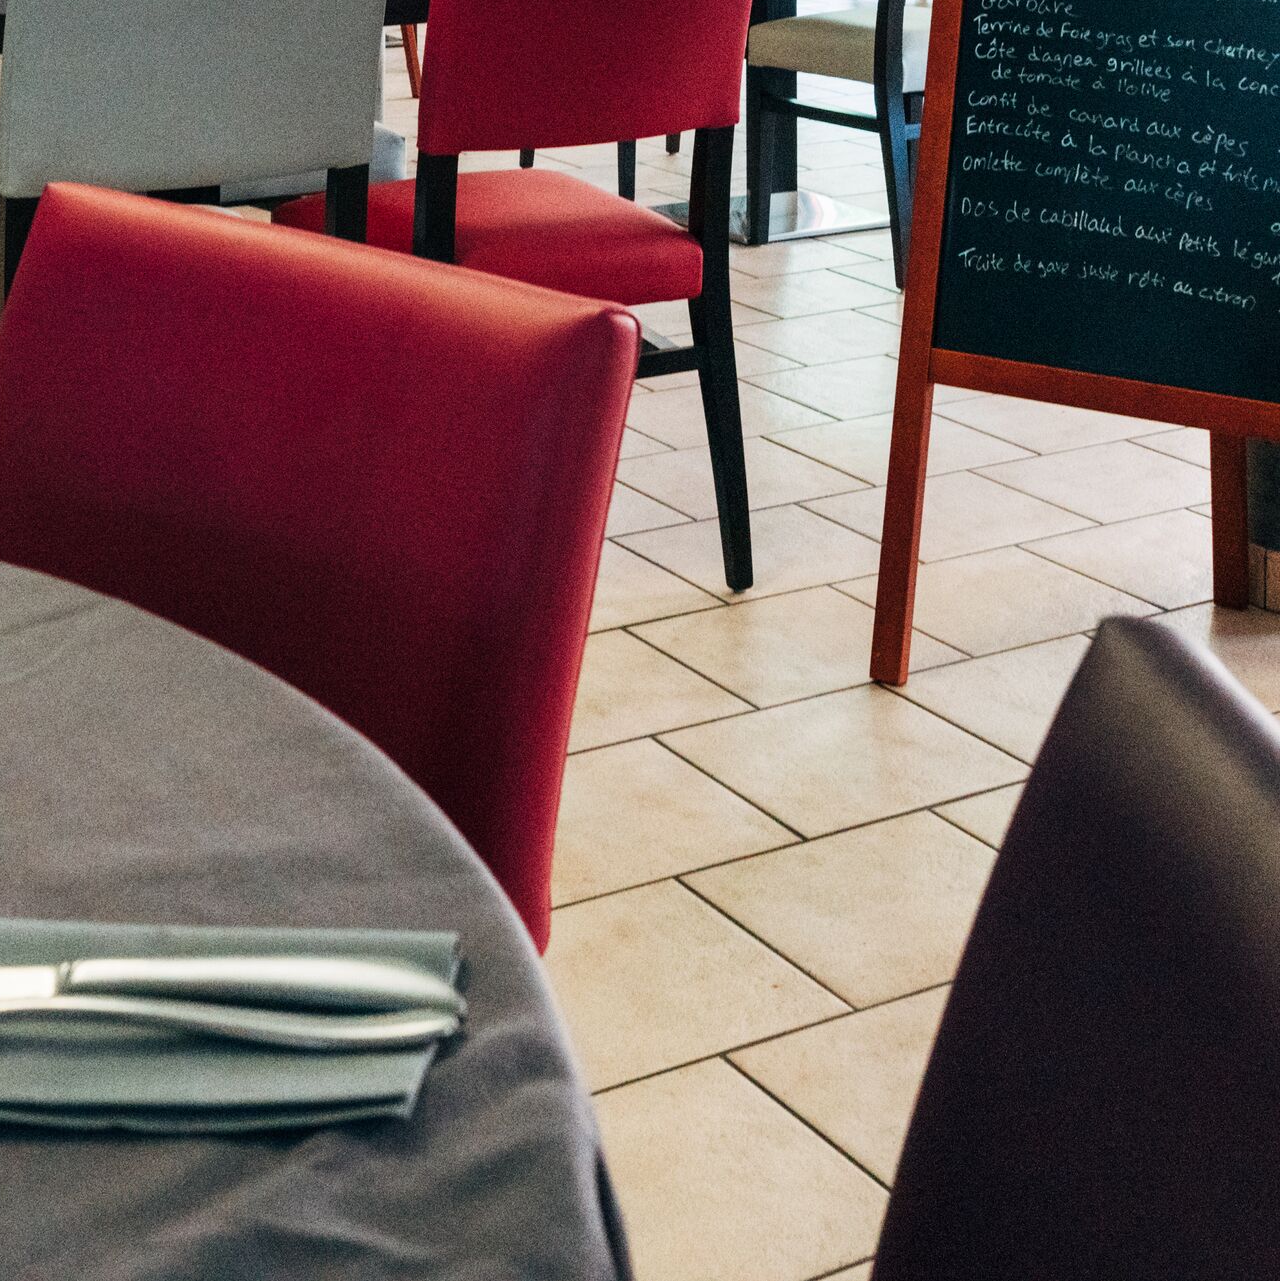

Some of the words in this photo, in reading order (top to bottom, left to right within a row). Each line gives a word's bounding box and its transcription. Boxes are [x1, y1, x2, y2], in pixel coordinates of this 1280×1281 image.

[973, 12, 1033, 36] Terrine
[1036, 21, 1054, 39] de
[1096, 29, 1134, 53] gras
[1138, 29, 1160, 48] et
[1162, 35, 1197, 52] son
[974, 37, 1019, 61] Côte
[1181, 65, 1198, 84] à
[1206, 69, 1227, 91] la
[991, 62, 1013, 80] de
[1017, 67, 1081, 90] tomate
[1087, 75, 1105, 91] à
[1116, 78, 1171, 102] l'olive
[967, 90, 1018, 109] Confit
[1027, 95, 1053, 118] de
[1067, 108, 1141, 133] canard
[1146, 121, 1182, 140] aux
[1191, 125, 1249, 158] cèpes
[1060, 128, 1079, 149] à
[1088, 133, 1108, 157] la
[1123, 179, 1159, 195] aux
[961, 196, 1000, 218] Dos
[1004, 200, 1032, 223] de
[1012, 253, 1032, 274] de
